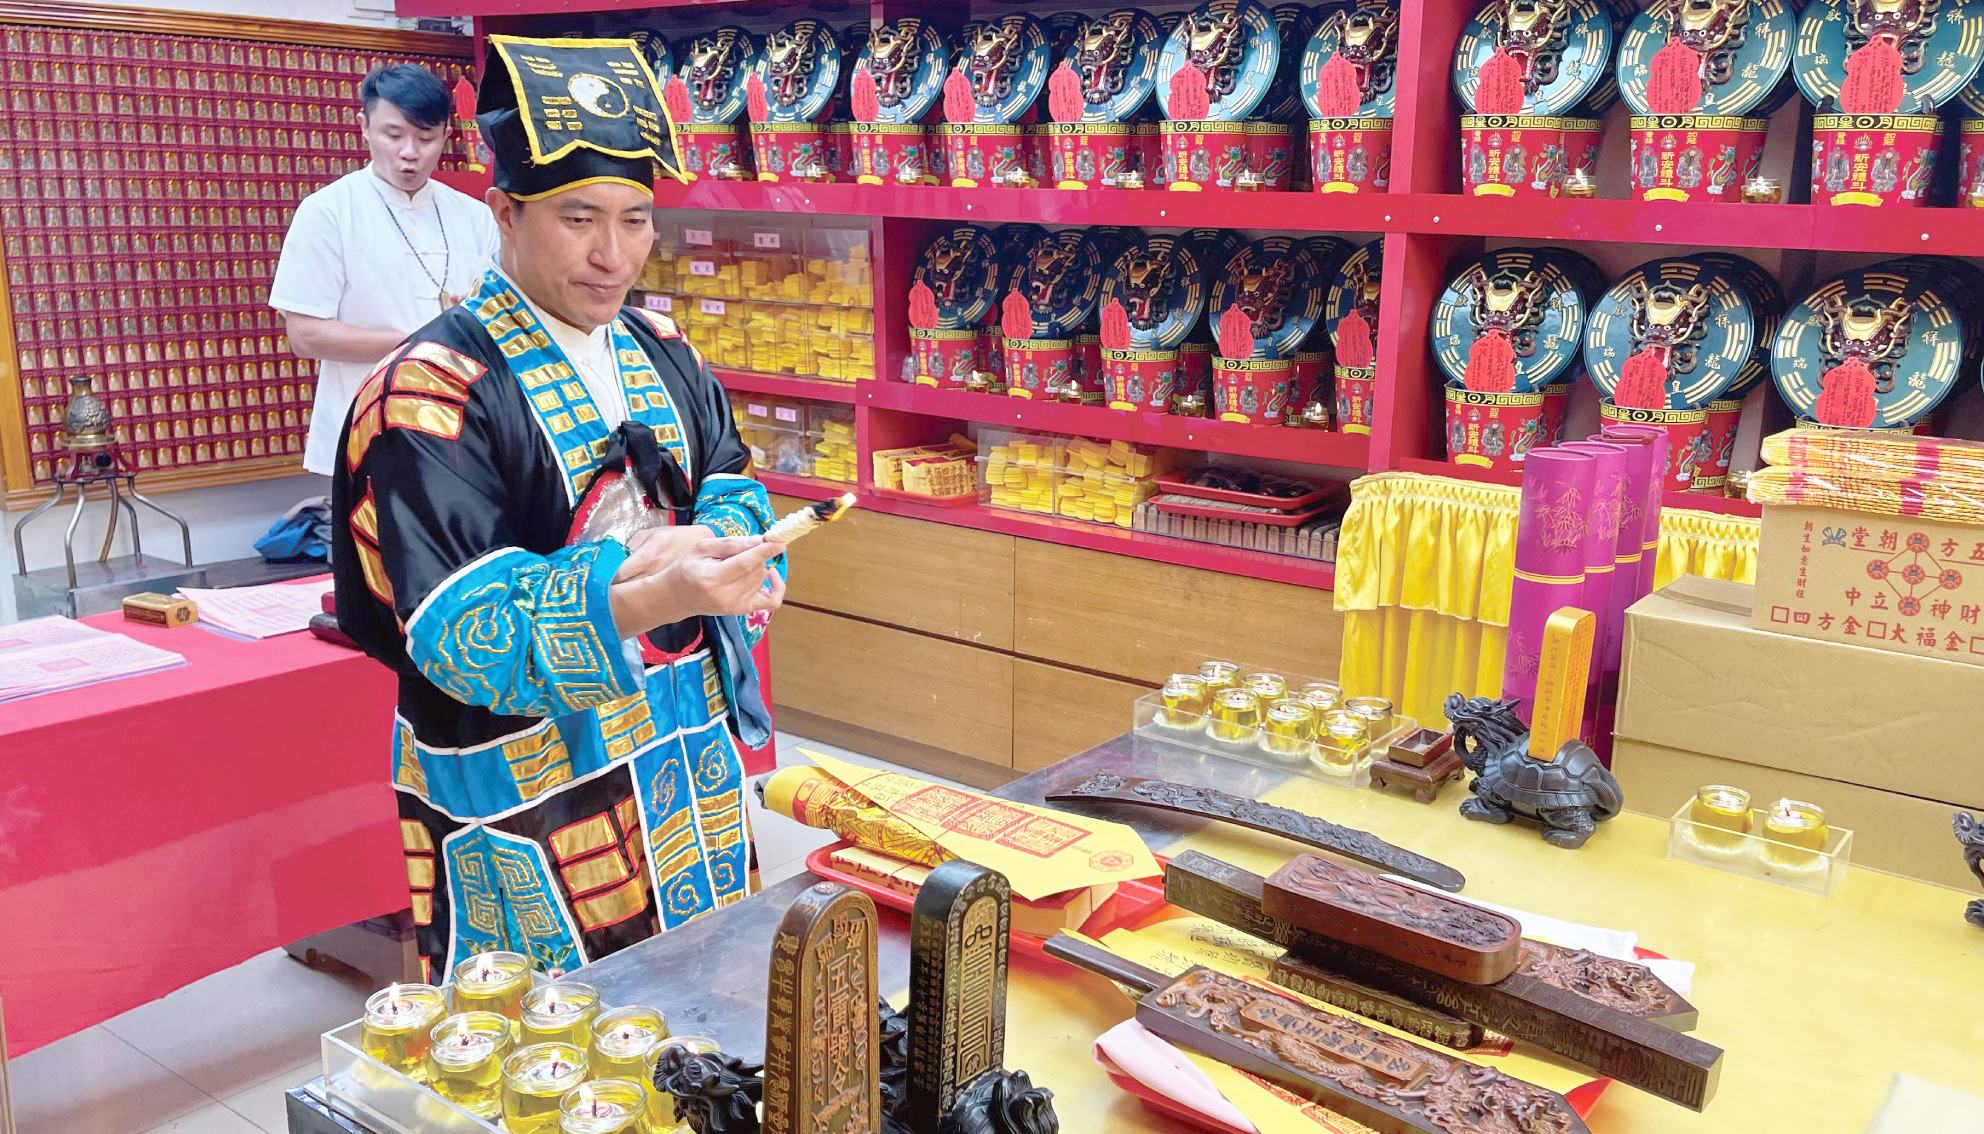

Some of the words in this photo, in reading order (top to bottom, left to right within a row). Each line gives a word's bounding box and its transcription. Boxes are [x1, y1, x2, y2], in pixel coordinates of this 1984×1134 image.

[1793, 611, 1863, 636] 四方金
[1889, 622, 1966, 652] 大福金
